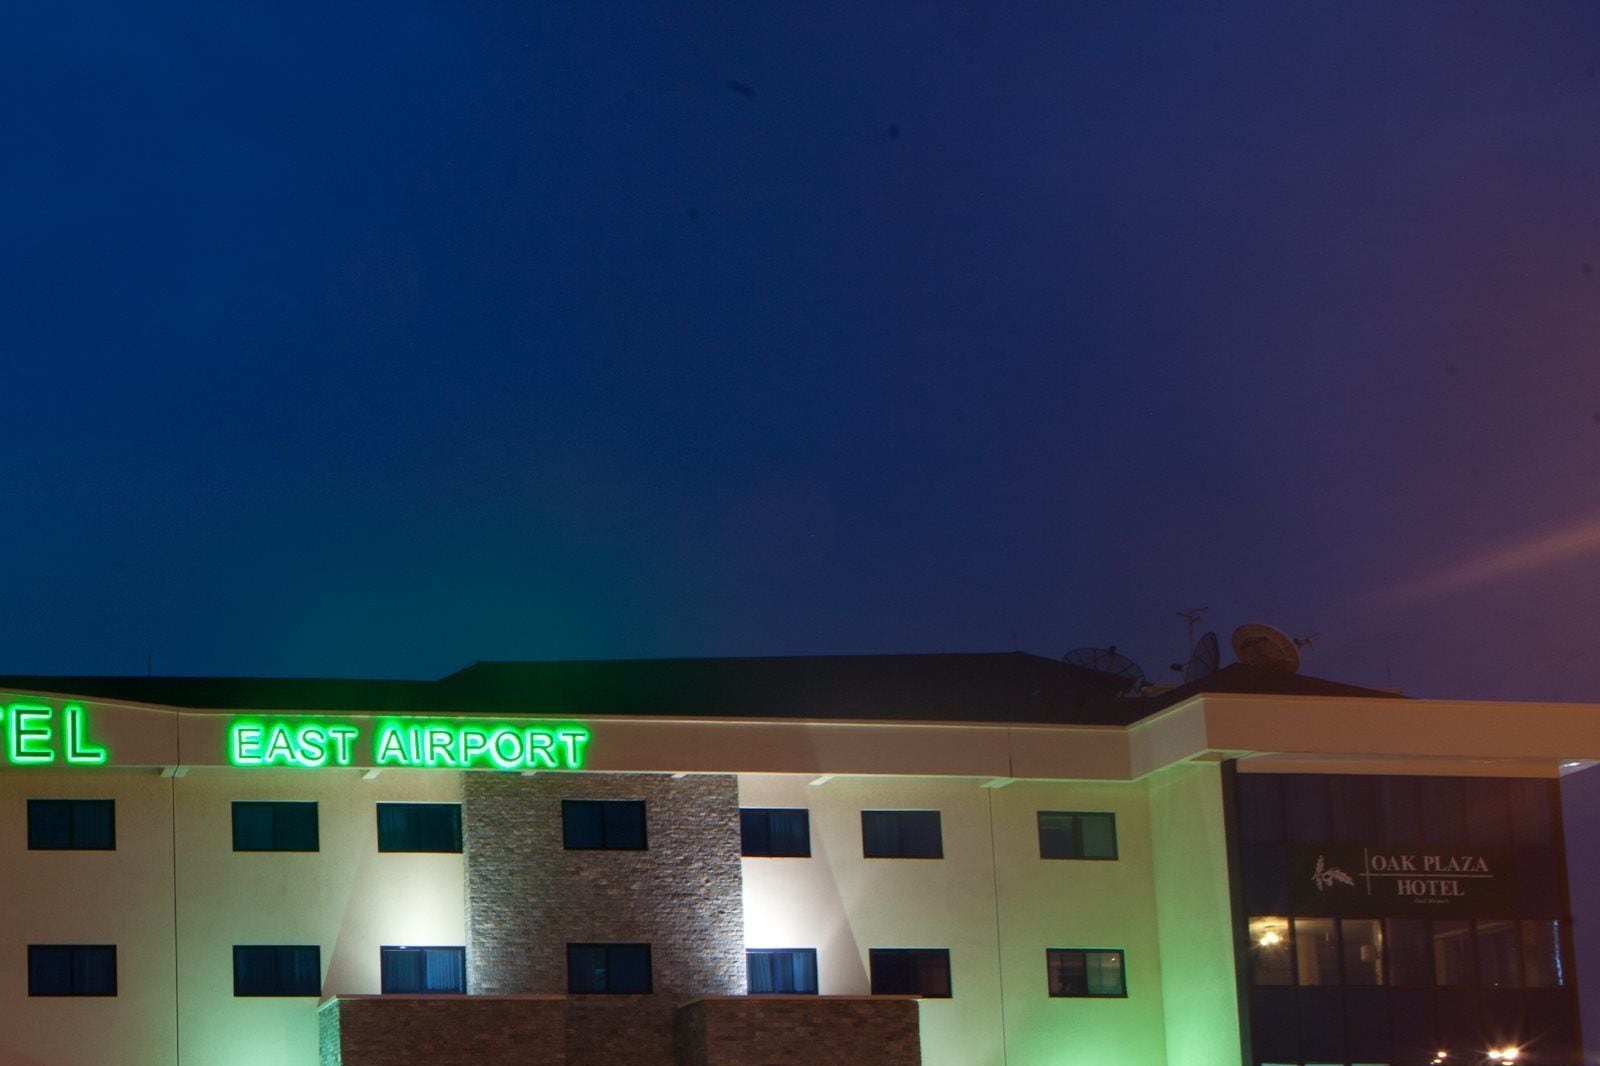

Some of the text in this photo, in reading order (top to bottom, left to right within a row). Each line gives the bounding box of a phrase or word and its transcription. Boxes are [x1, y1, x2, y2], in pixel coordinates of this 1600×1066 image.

[233, 726, 589, 768] EAST AIRPORT
[1371, 855, 1489, 872] OAK PLAZA
[1397, 879, 1465, 896] HOTEL
